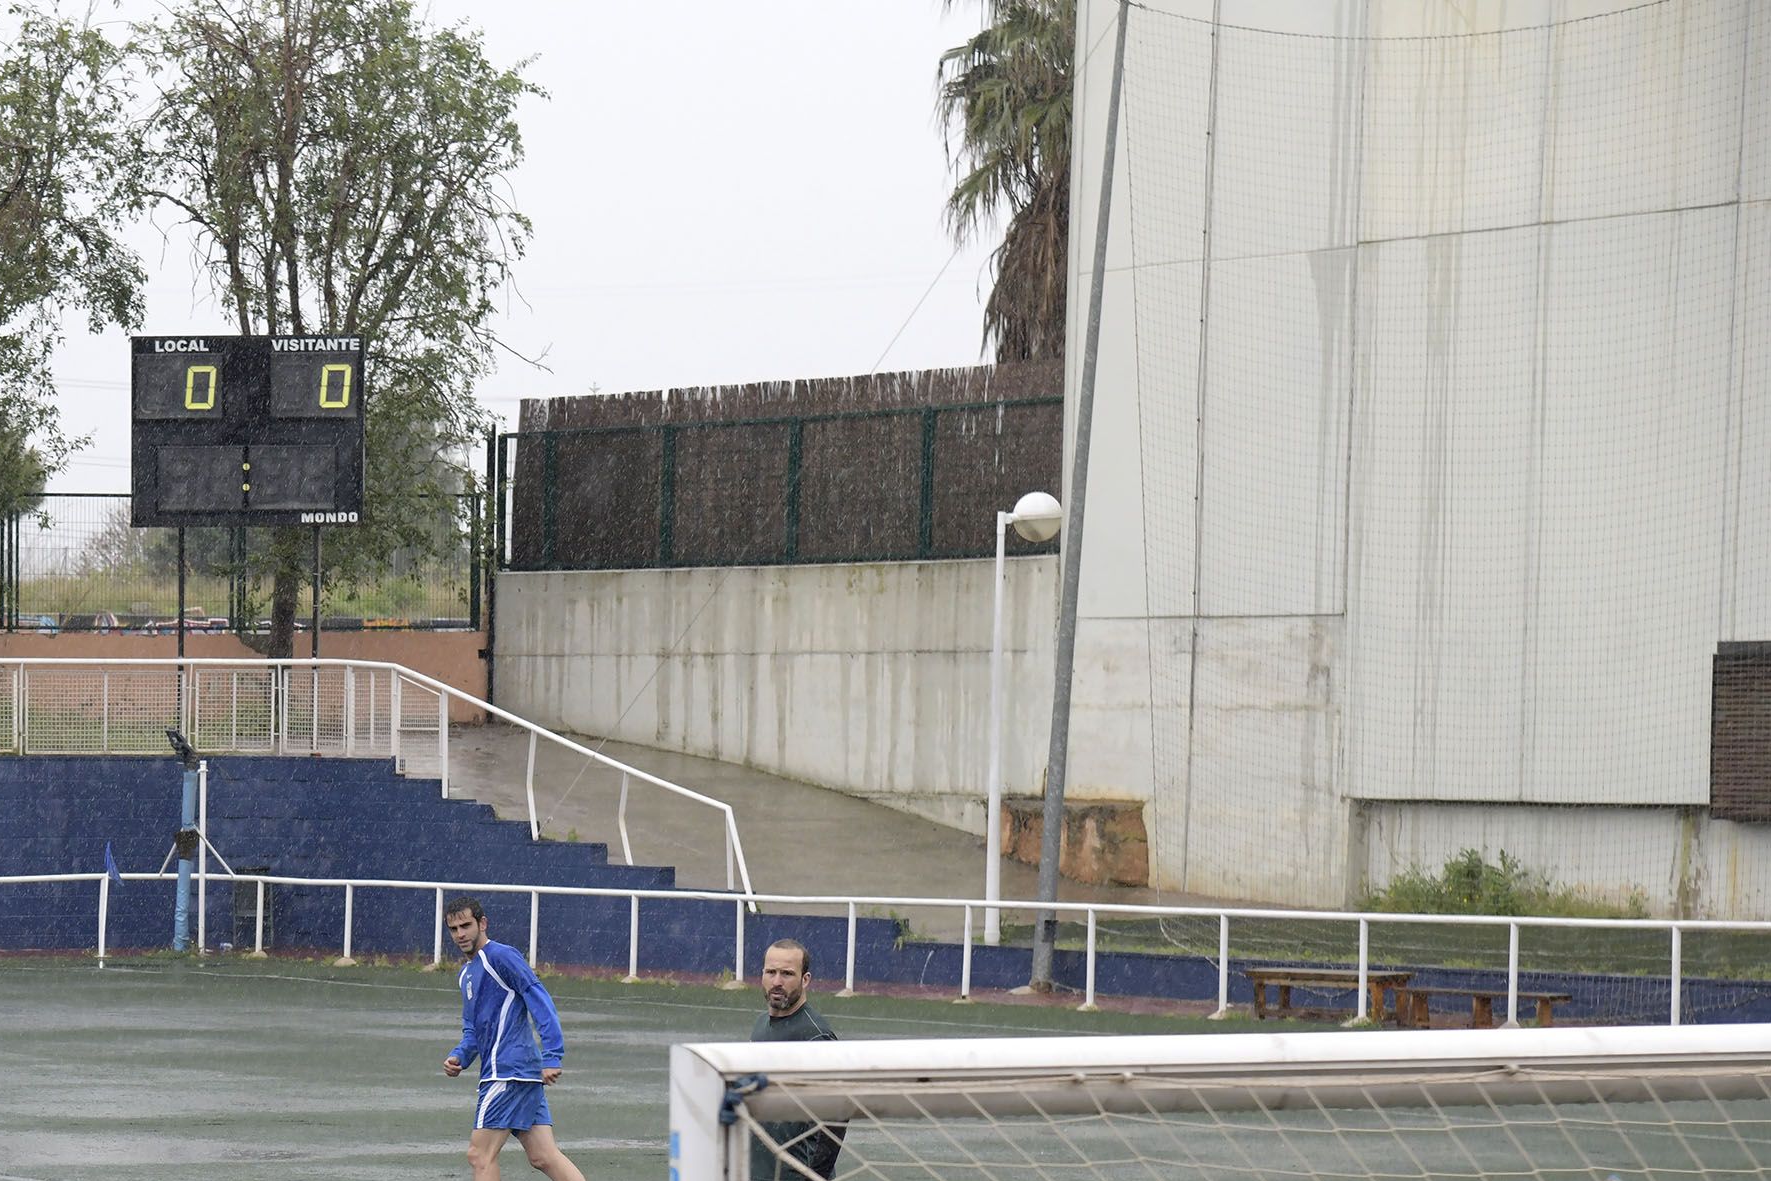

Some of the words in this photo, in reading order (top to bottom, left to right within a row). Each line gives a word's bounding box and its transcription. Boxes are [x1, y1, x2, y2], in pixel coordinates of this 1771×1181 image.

[155, 340, 209, 352] LOCAL
[271, 338, 360, 351] VISITANTE
[184, 365, 217, 409] 0
[319, 364, 352, 408] 0
[301, 512, 358, 523] MONDO
